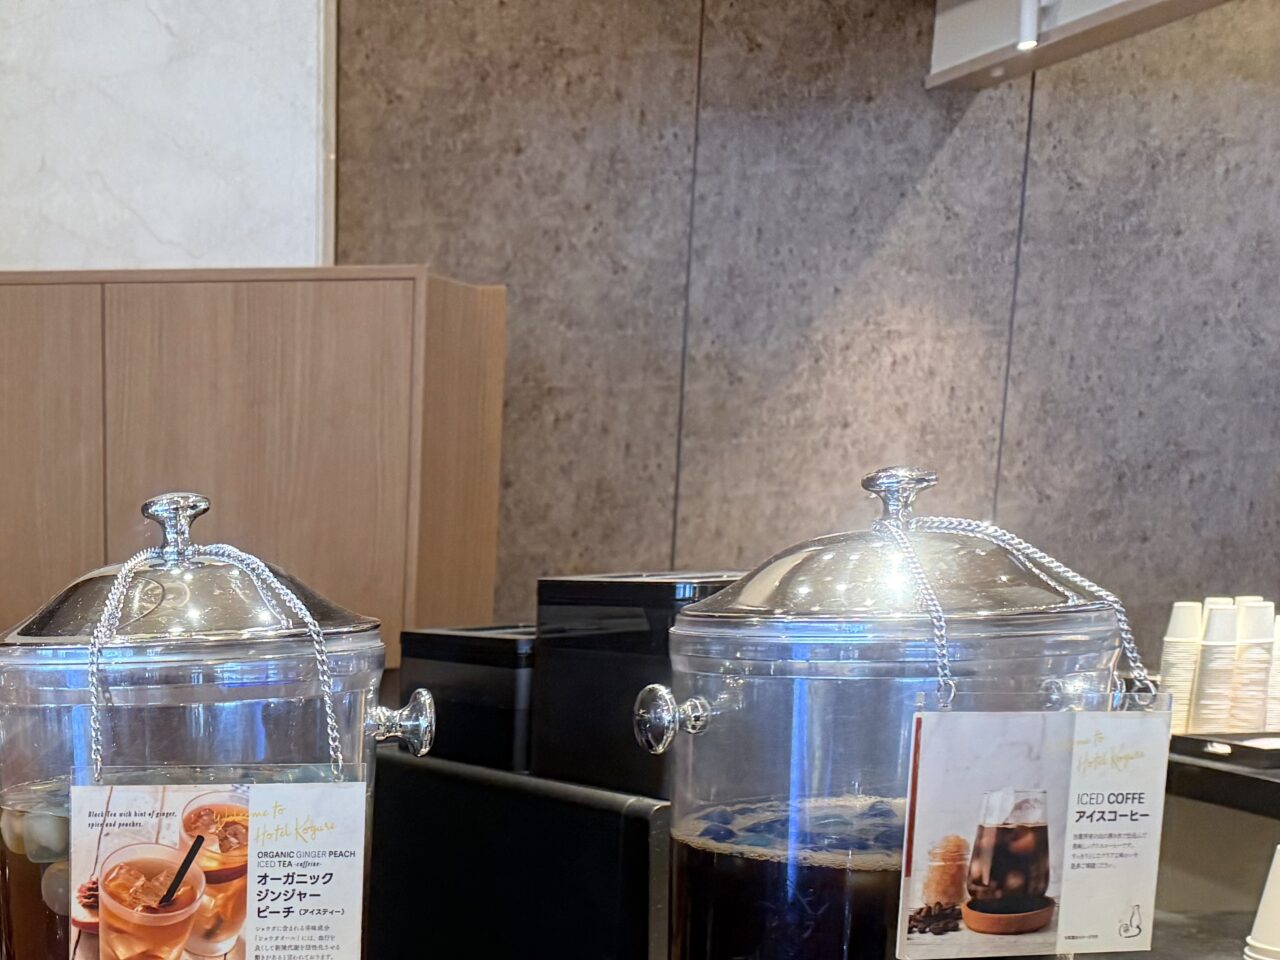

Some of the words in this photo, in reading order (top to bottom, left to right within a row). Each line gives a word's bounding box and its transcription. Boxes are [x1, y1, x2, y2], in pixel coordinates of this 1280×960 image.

[1077, 793, 1105, 805] ICED
[1107, 792, 1145, 804] COFFE
[88, 810, 104, 818] Black
[106, 810, 117, 818] Tea
[119, 810, 132, 818] with
[134, 810, 146, 818] hint
[148, 809, 155, 819] of
[272, 800, 287, 818] to
[1075, 810, 1150, 822] アイスコーヒー
[105, 820, 116, 828] and
[255, 823, 291, 847] Hotel
[257, 851, 295, 859] ORGANIC
[296, 850, 327, 858] GINGER
[328, 850, 356, 858] PEACH
[278, 860, 293, 868] TEA
[257, 872, 334, 885] オーガニック
[256, 889, 321, 902] ジンジャー
[257, 906, 295, 919] ピーチ
